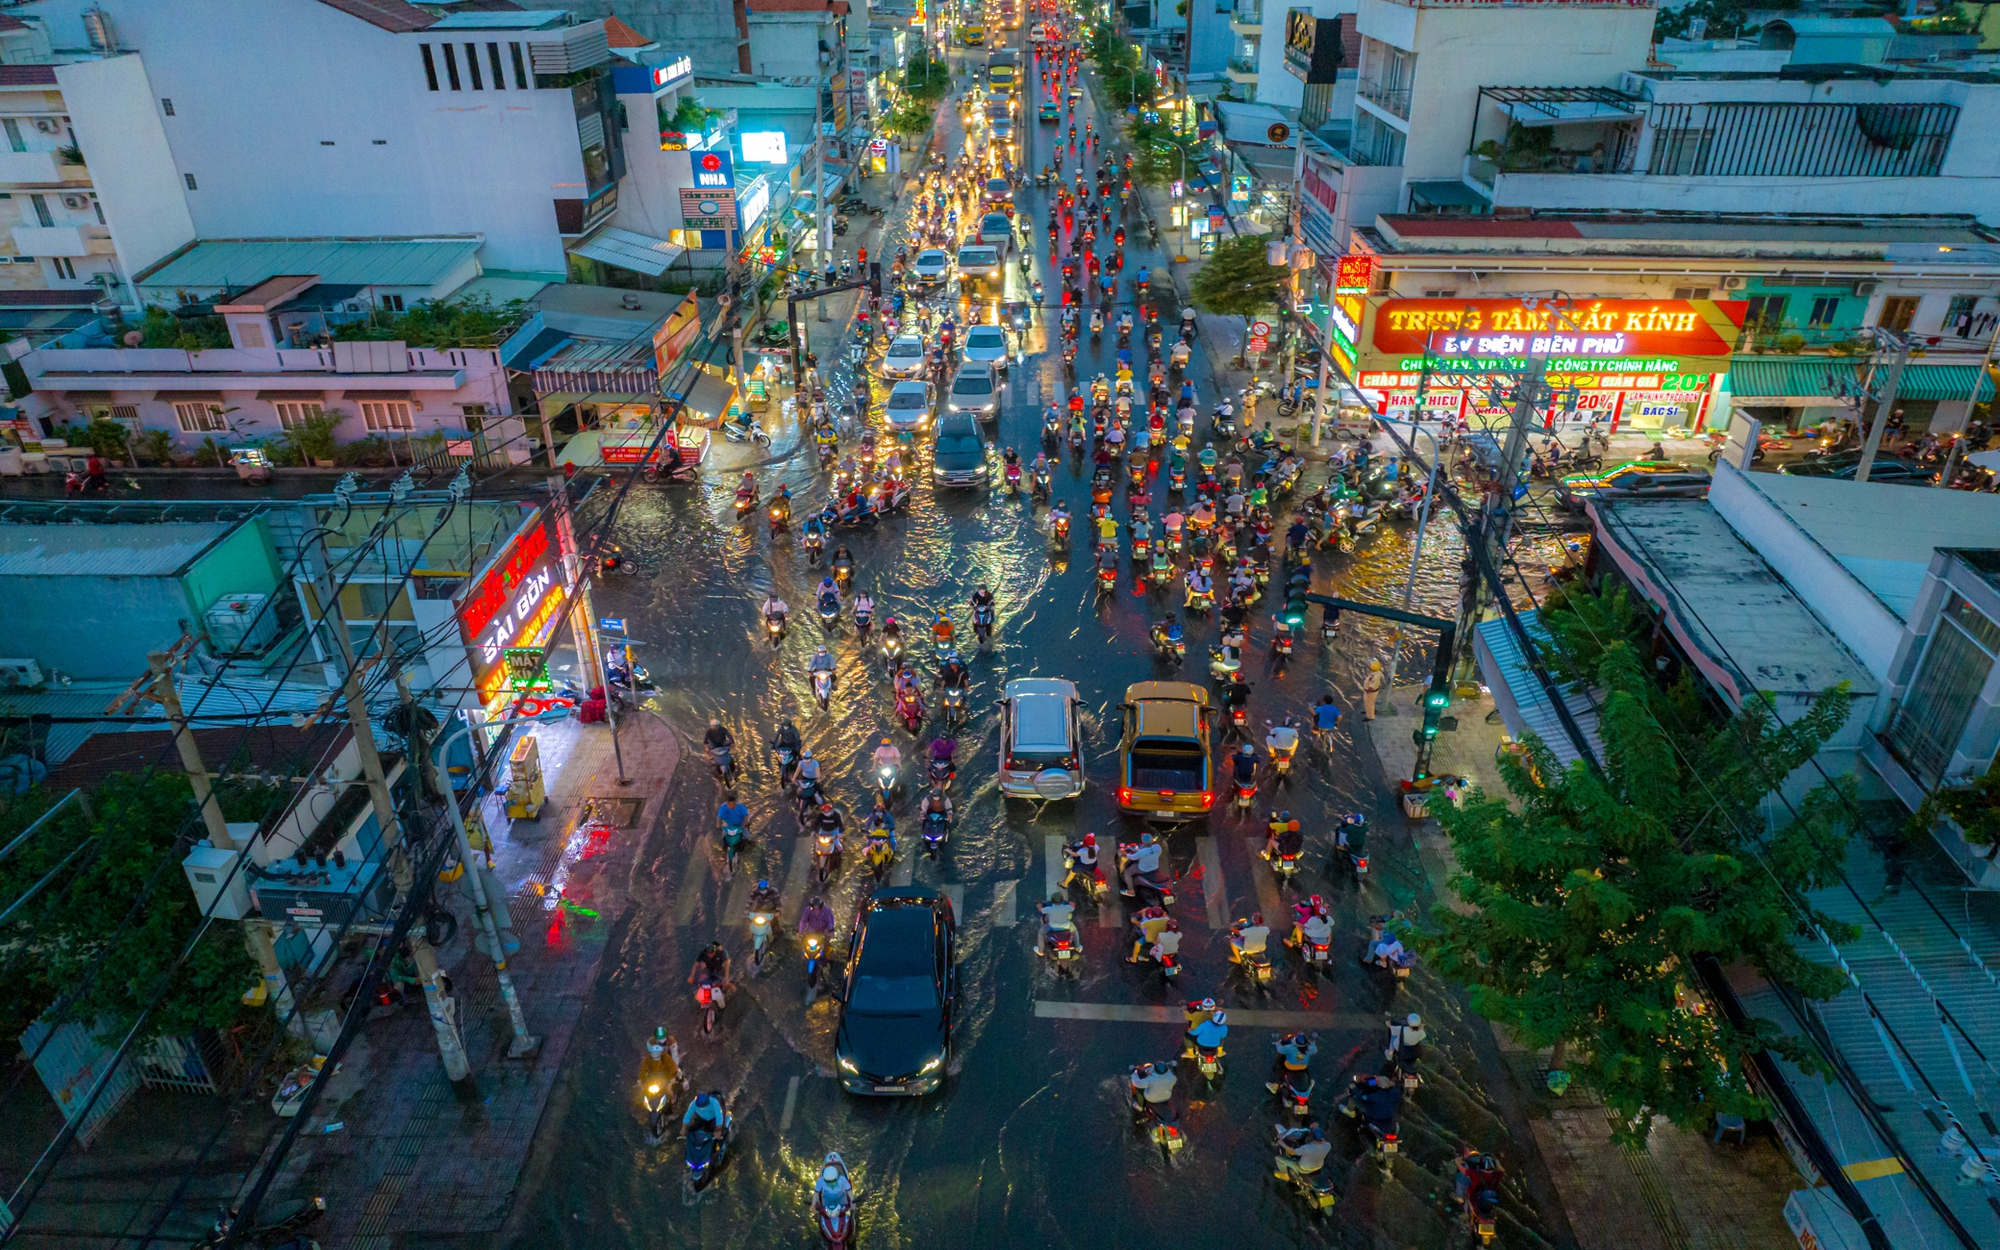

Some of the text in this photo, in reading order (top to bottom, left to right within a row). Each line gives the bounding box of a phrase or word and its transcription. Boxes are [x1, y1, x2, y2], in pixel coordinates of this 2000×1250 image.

[700, 173, 727, 186] NHA
[1389, 303, 1698, 332] TRUNG TÂM MẮT KÍNH
[1478, 335, 1525, 354] ĐIỆN
[1582, 333, 1625, 353] PHỦ
[1555, 359, 1588, 371] CÔNG
[1590, 361, 1606, 371] TY
[1606, 358, 1642, 371] CHÍNH
[1645, 359, 1679, 372] HÃNG
[1363, 372, 1398, 387] CHÀO
[1400, 373, 1423, 386] ĐÓ
[1601, 374, 1633, 388] GIẢM
[1636, 374, 1659, 387] GIÁ
[1391, 393, 1426, 406] HÀN
[1577, 394, 1613, 410] 20%
[540, 585, 563, 623] HÃNG
[483, 565, 551, 664] SÀI GÒN
[510, 652, 540, 667] MẮT
